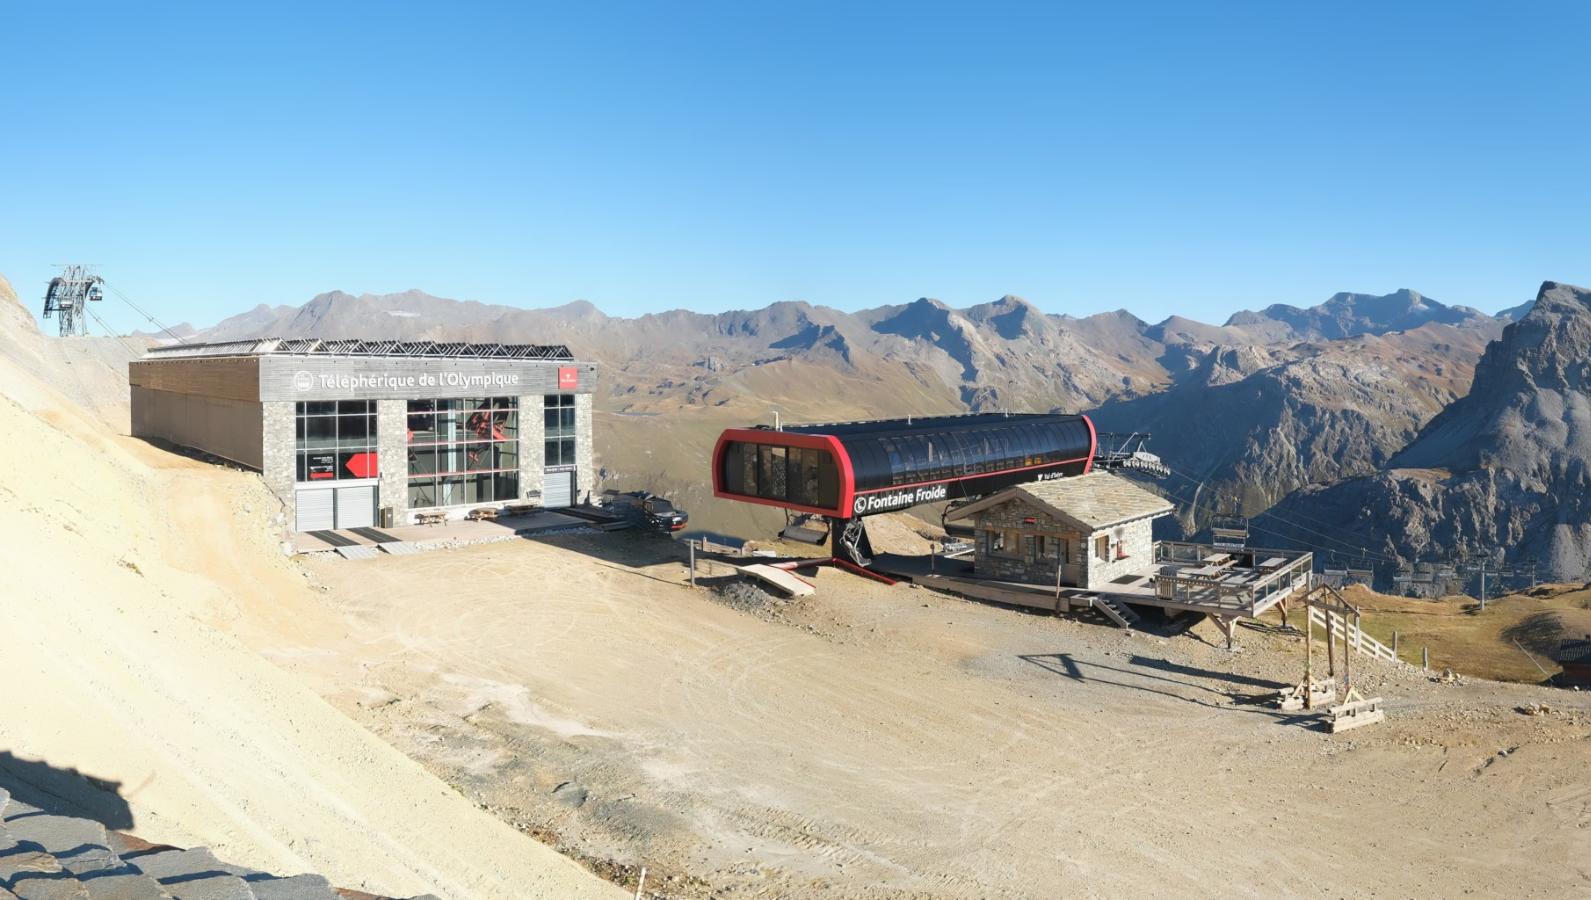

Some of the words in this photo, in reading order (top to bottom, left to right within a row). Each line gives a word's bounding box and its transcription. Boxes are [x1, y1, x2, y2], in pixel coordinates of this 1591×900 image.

[319, 372, 415, 391] Téléphérique
[419, 373, 436, 387] de
[439, 373, 519, 388] l'Olympique
[867, 492, 914, 510] Fontaine
[915, 485, 946, 501] Froide
